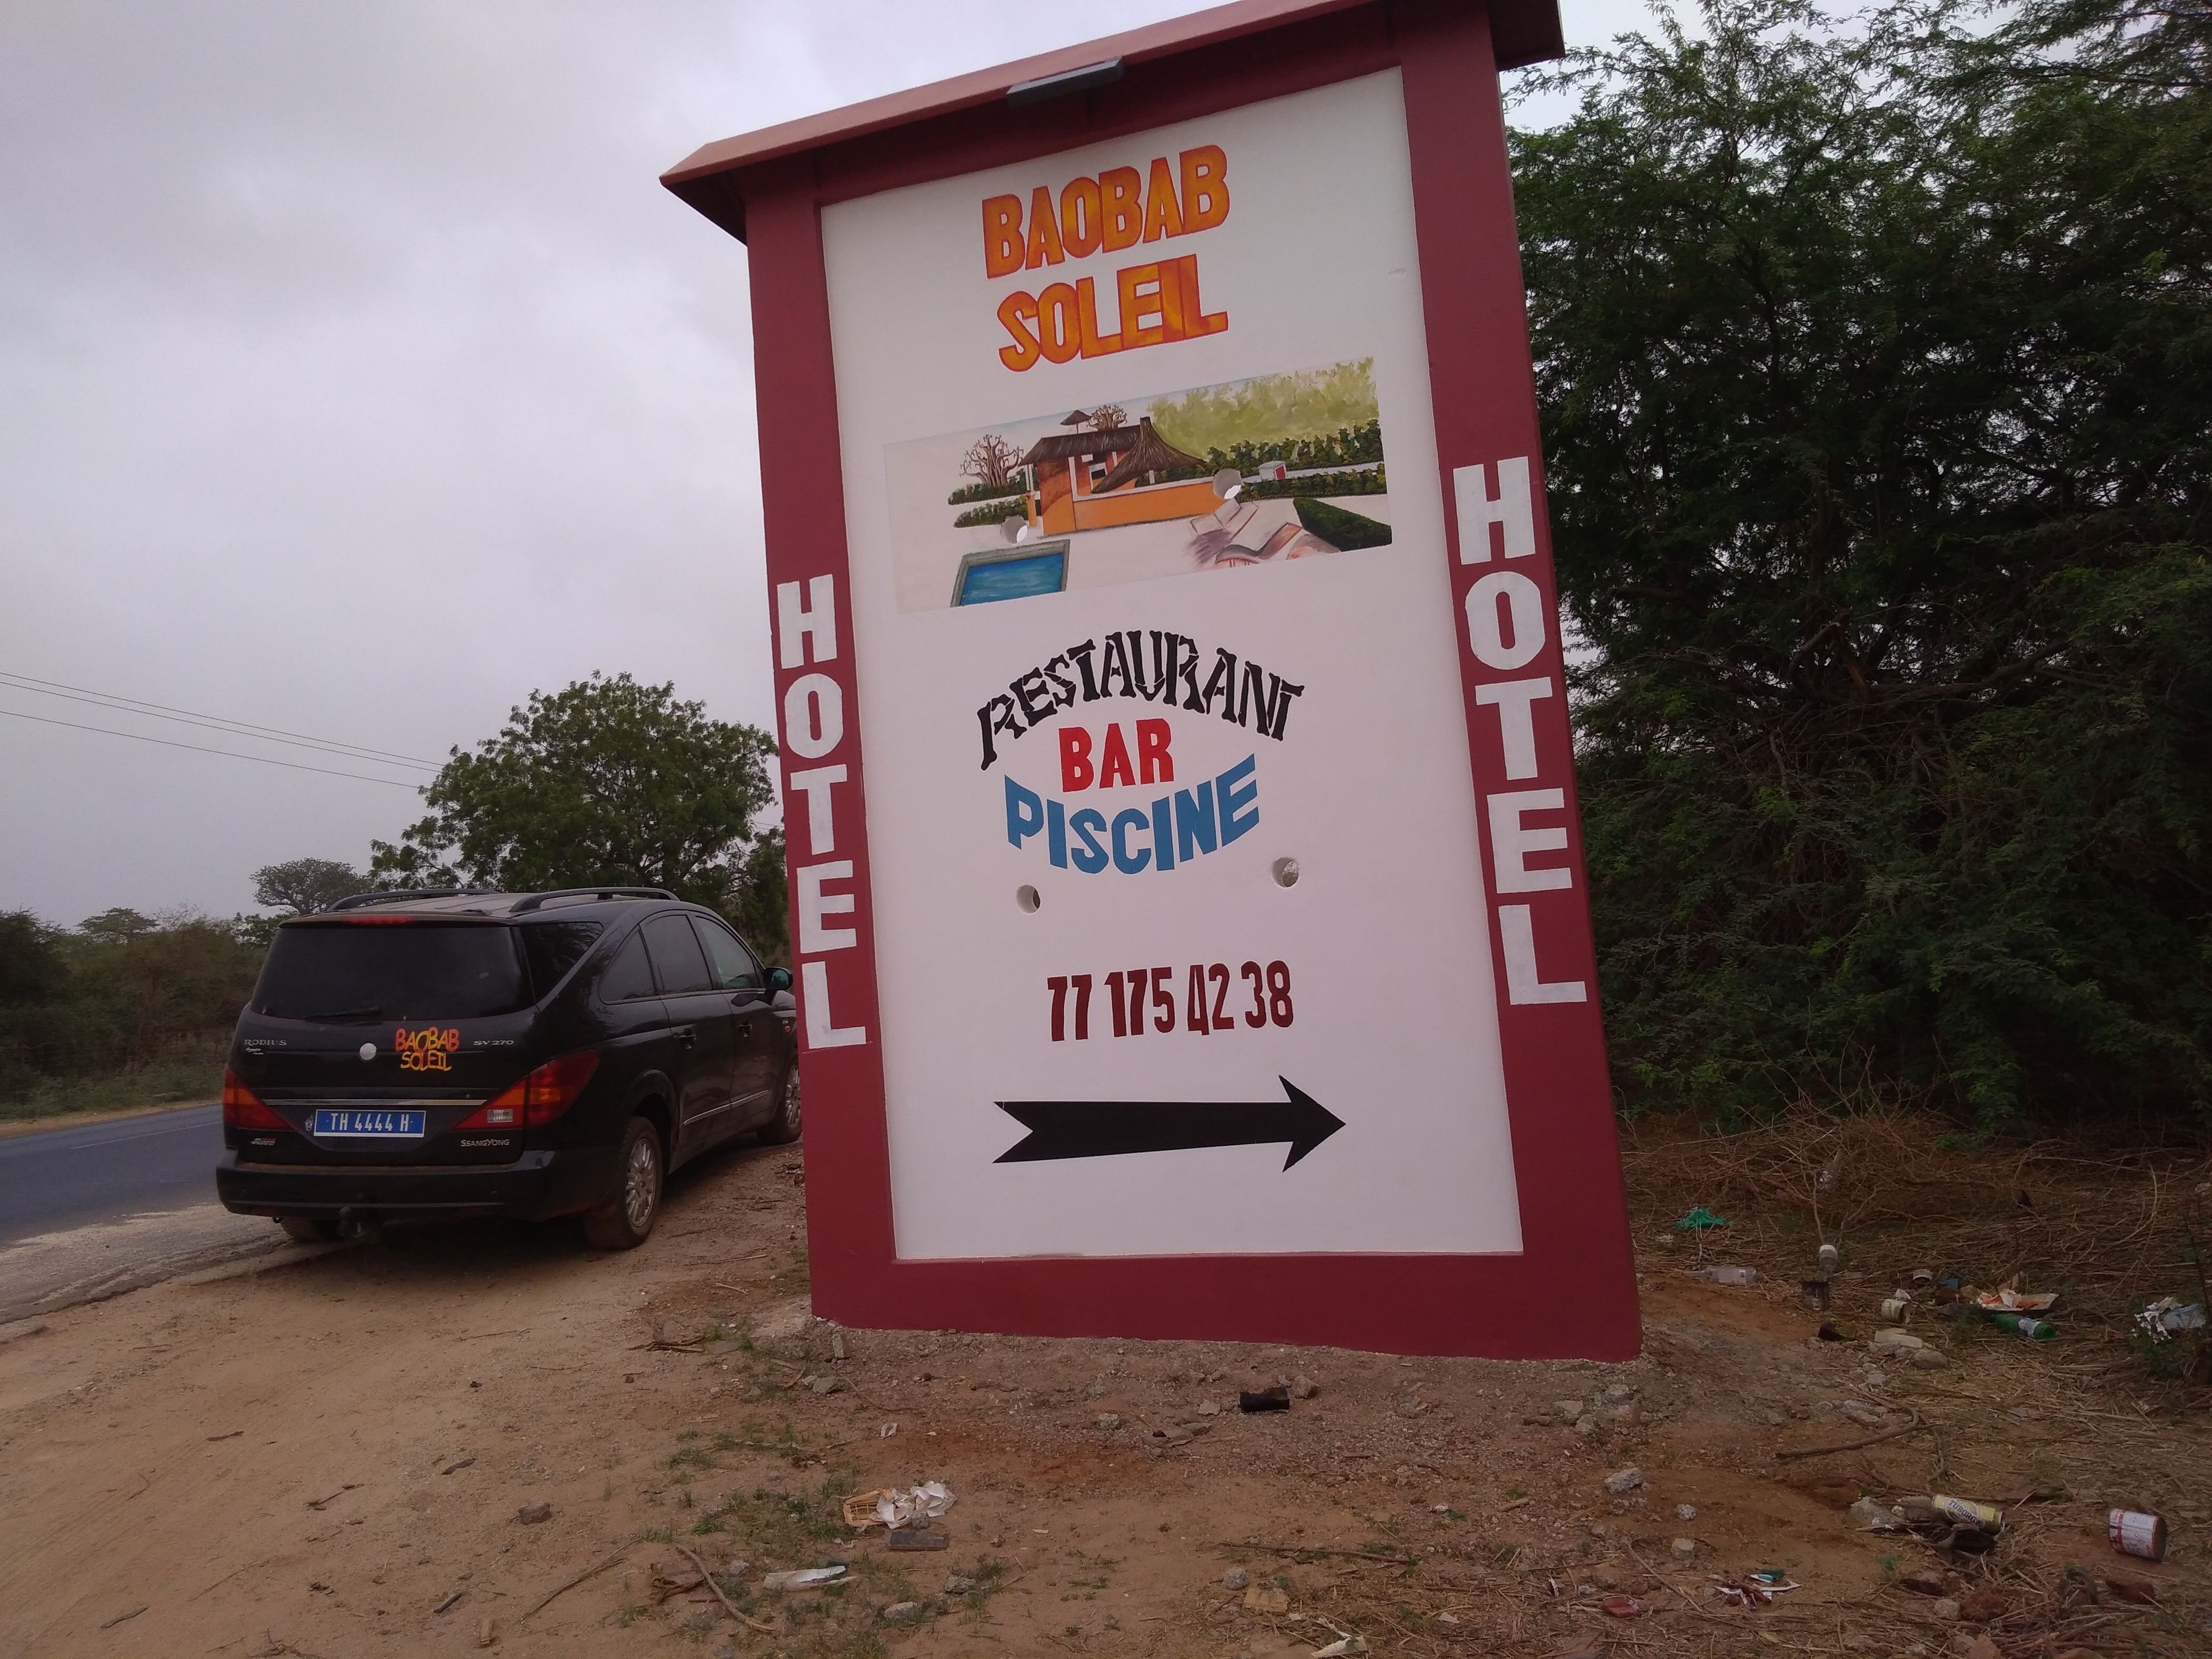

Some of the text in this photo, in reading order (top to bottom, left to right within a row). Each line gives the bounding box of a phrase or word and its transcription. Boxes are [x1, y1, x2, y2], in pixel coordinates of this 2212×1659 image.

[982, 145, 1230, 279] BAOBAB
[997, 253, 1228, 372] SOLEIL
[977, 630, 1305, 771] RESTAURANT
[1453, 455, 1588, 1006] HOTEL
[1058, 718, 1175, 793] BAR
[777, 574, 866, 1050] HOTEL
[1004, 752, 1260, 874] PISCINE
[395, 1026, 459, 1052] BAOBAB
[1047, 960, 1294, 1041] 77 175 42 38
[400, 1050, 452, 1071] SOLEIL
[331, 1113, 409, 1131] TH 4444 H
[1949, 1499, 1978, 1524] TUBORG
